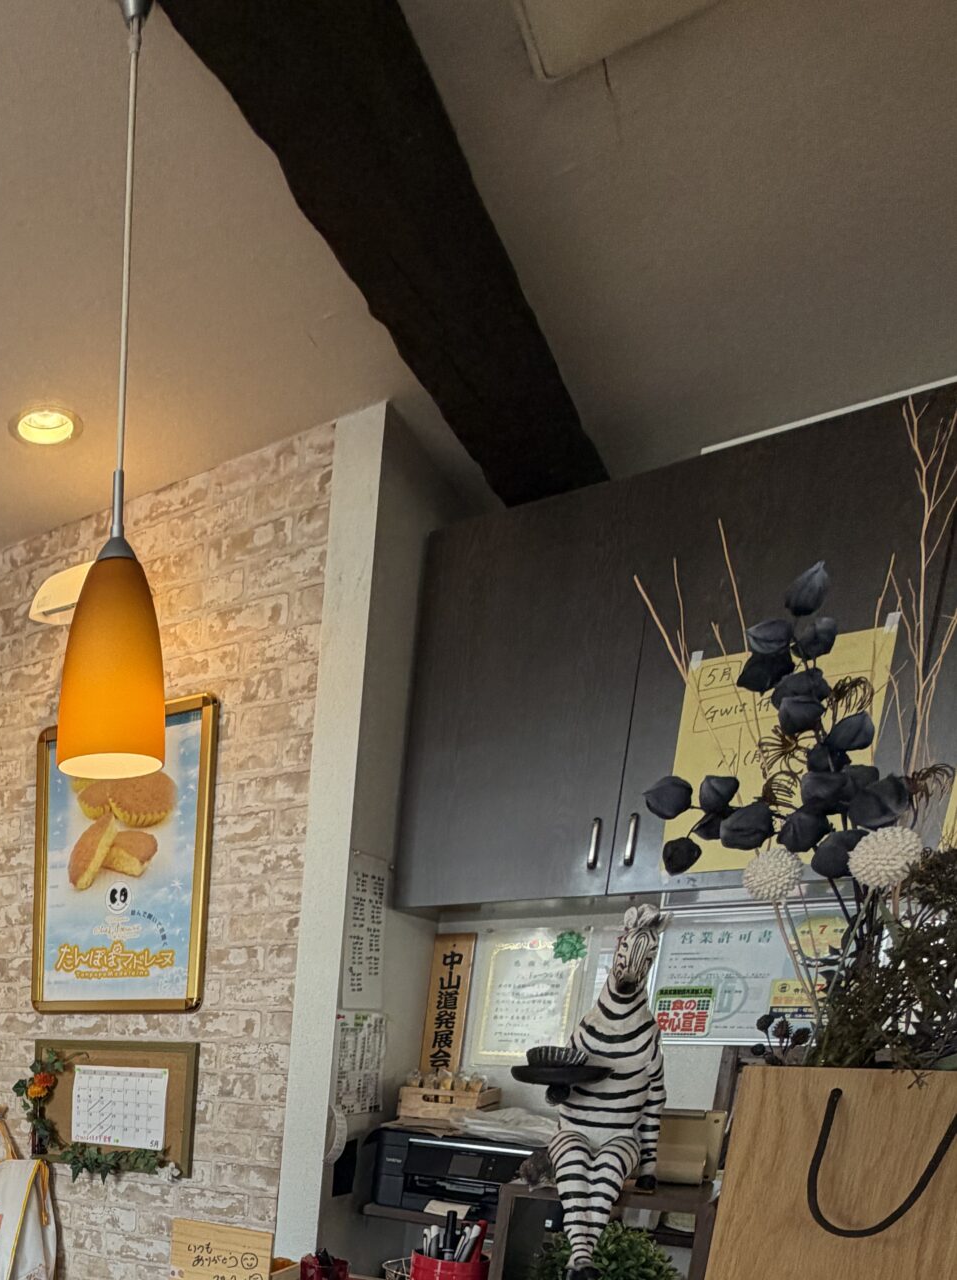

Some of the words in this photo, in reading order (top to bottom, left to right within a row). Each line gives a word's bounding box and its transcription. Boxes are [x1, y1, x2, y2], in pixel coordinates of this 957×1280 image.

[819, 925, 828, 934] 7
[56, 943, 174, 971] たんぽぽマドレーヌ
[429, 951, 463, 1075] 中山道発展会
[671, 999, 697, 1011] 食の
[657, 1012, 708, 1033] 安心宣言
[187, 1242, 213, 1254] いつも
[192, 1252, 238, 1268] ありがとう
